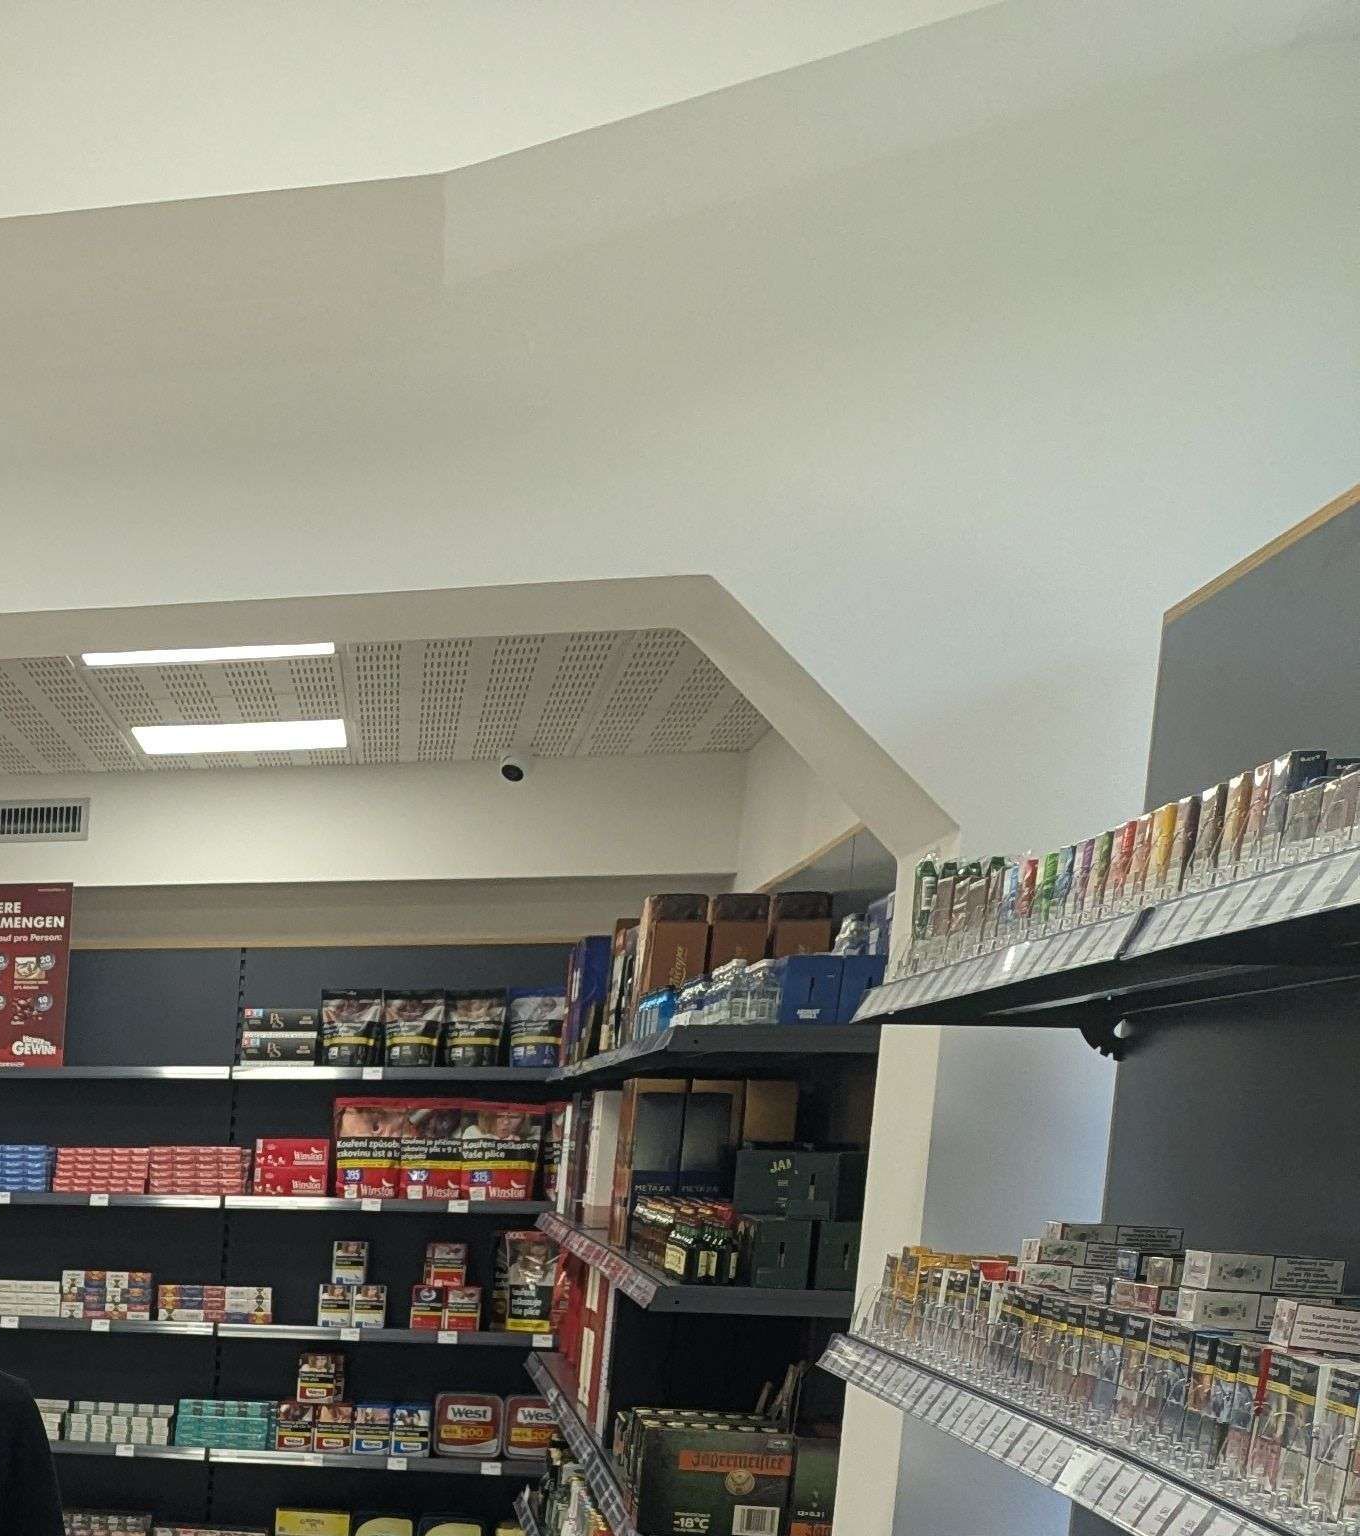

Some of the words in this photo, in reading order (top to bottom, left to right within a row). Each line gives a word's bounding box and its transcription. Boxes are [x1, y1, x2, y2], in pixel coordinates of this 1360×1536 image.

[13, 935, 28, 943] pro
[360, 1184, 395, 1197] Winston
[451, 1407, 488, 1419] West
